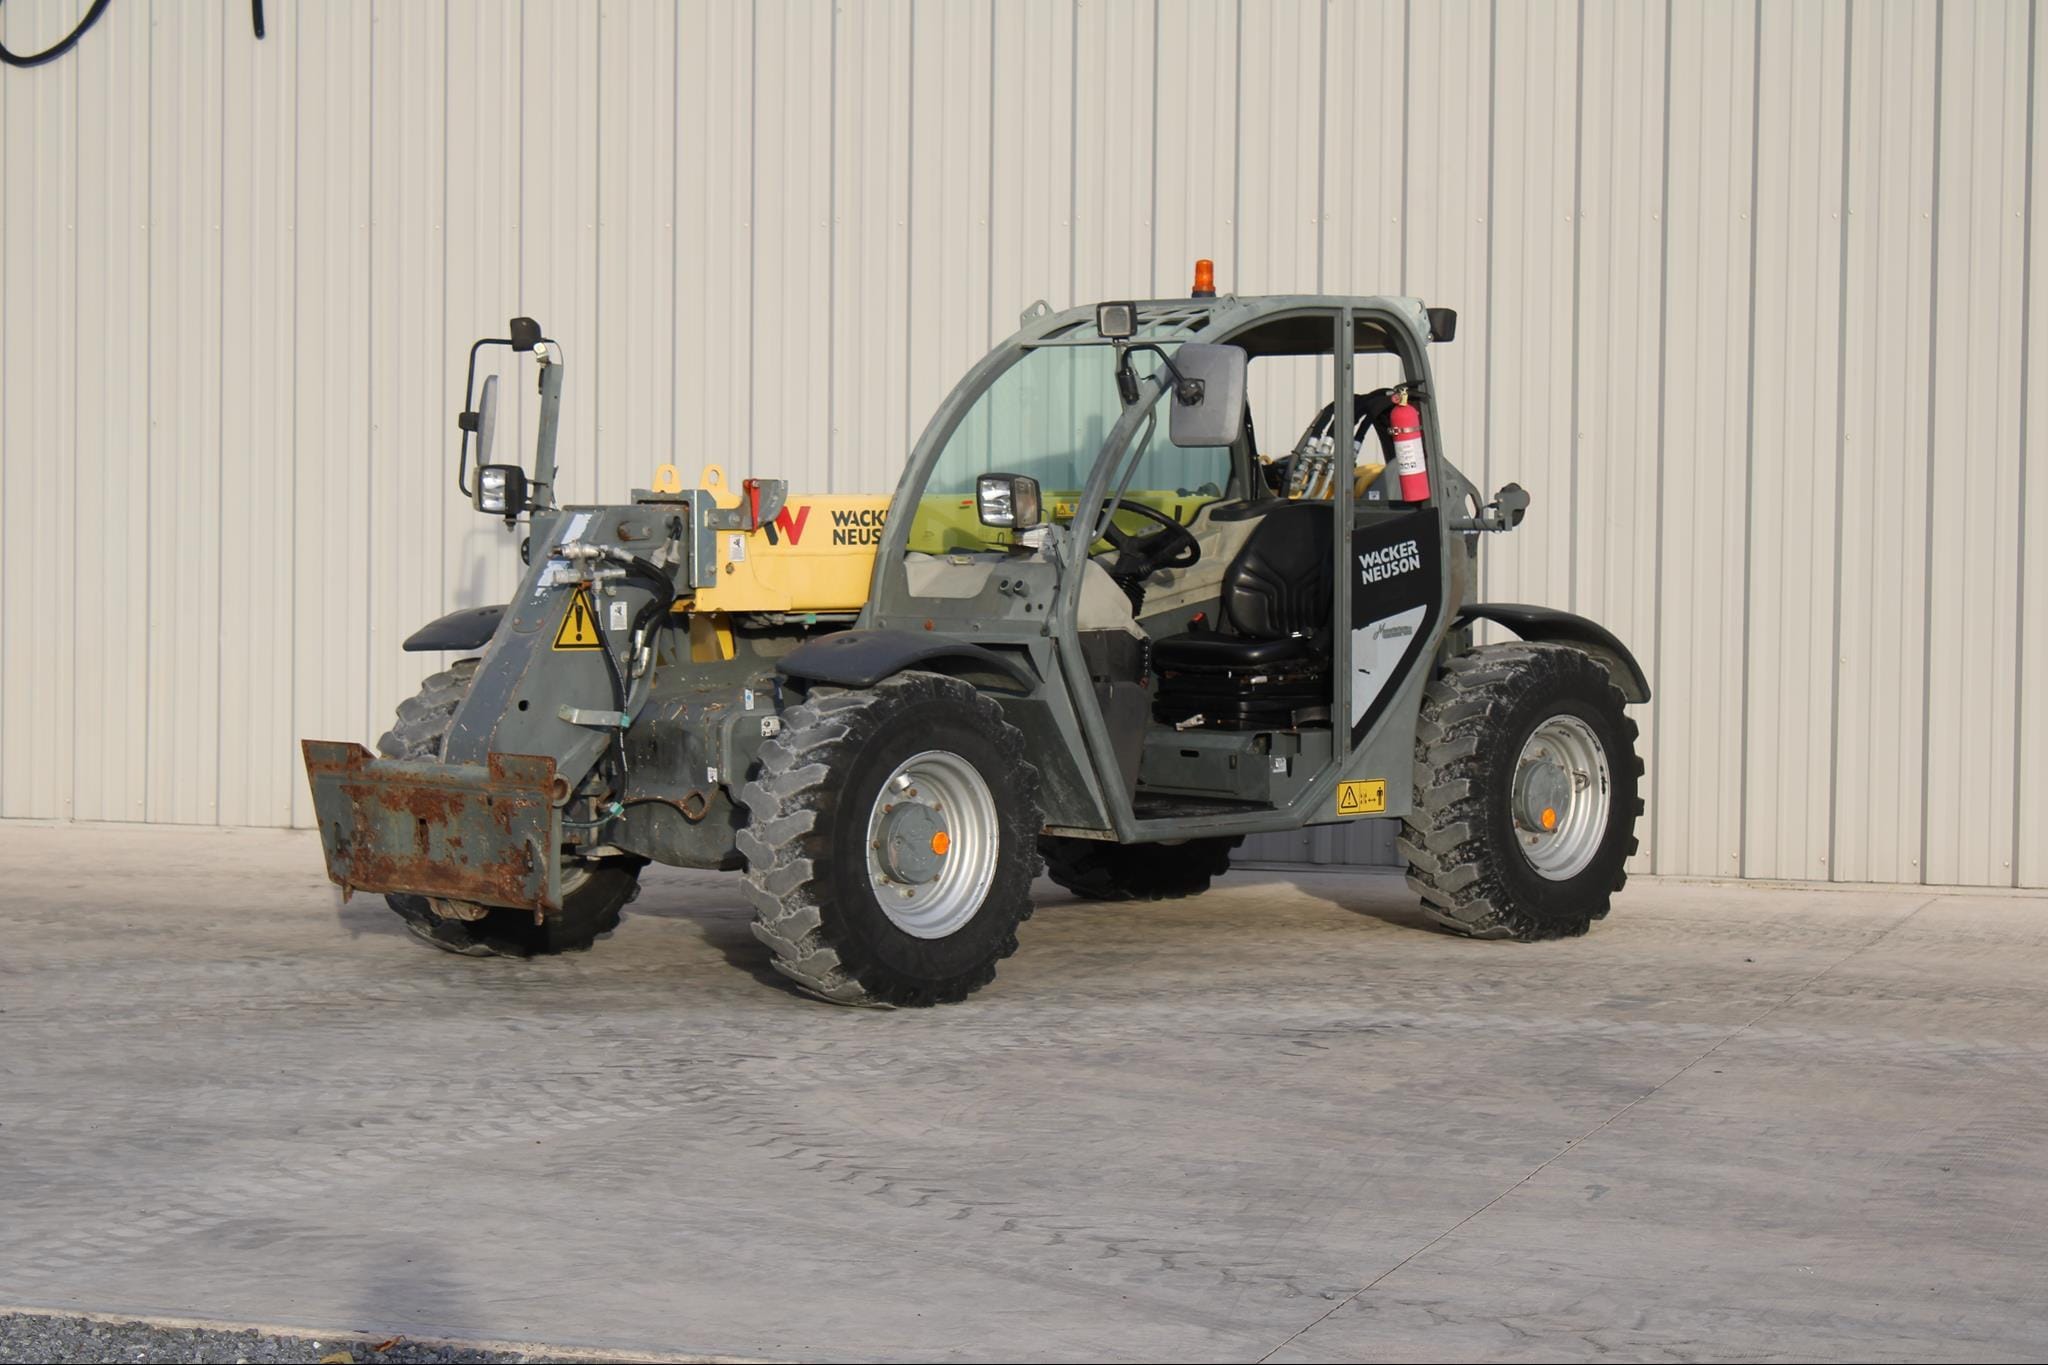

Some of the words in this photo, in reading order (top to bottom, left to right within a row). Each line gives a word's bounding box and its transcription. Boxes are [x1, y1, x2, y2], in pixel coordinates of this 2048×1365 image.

[831, 509, 889, 527] WACK
[832, 528, 882, 546] NEUS
[1358, 540, 1419, 569] WACKER
[1361, 554, 1421, 585] NEUSON
